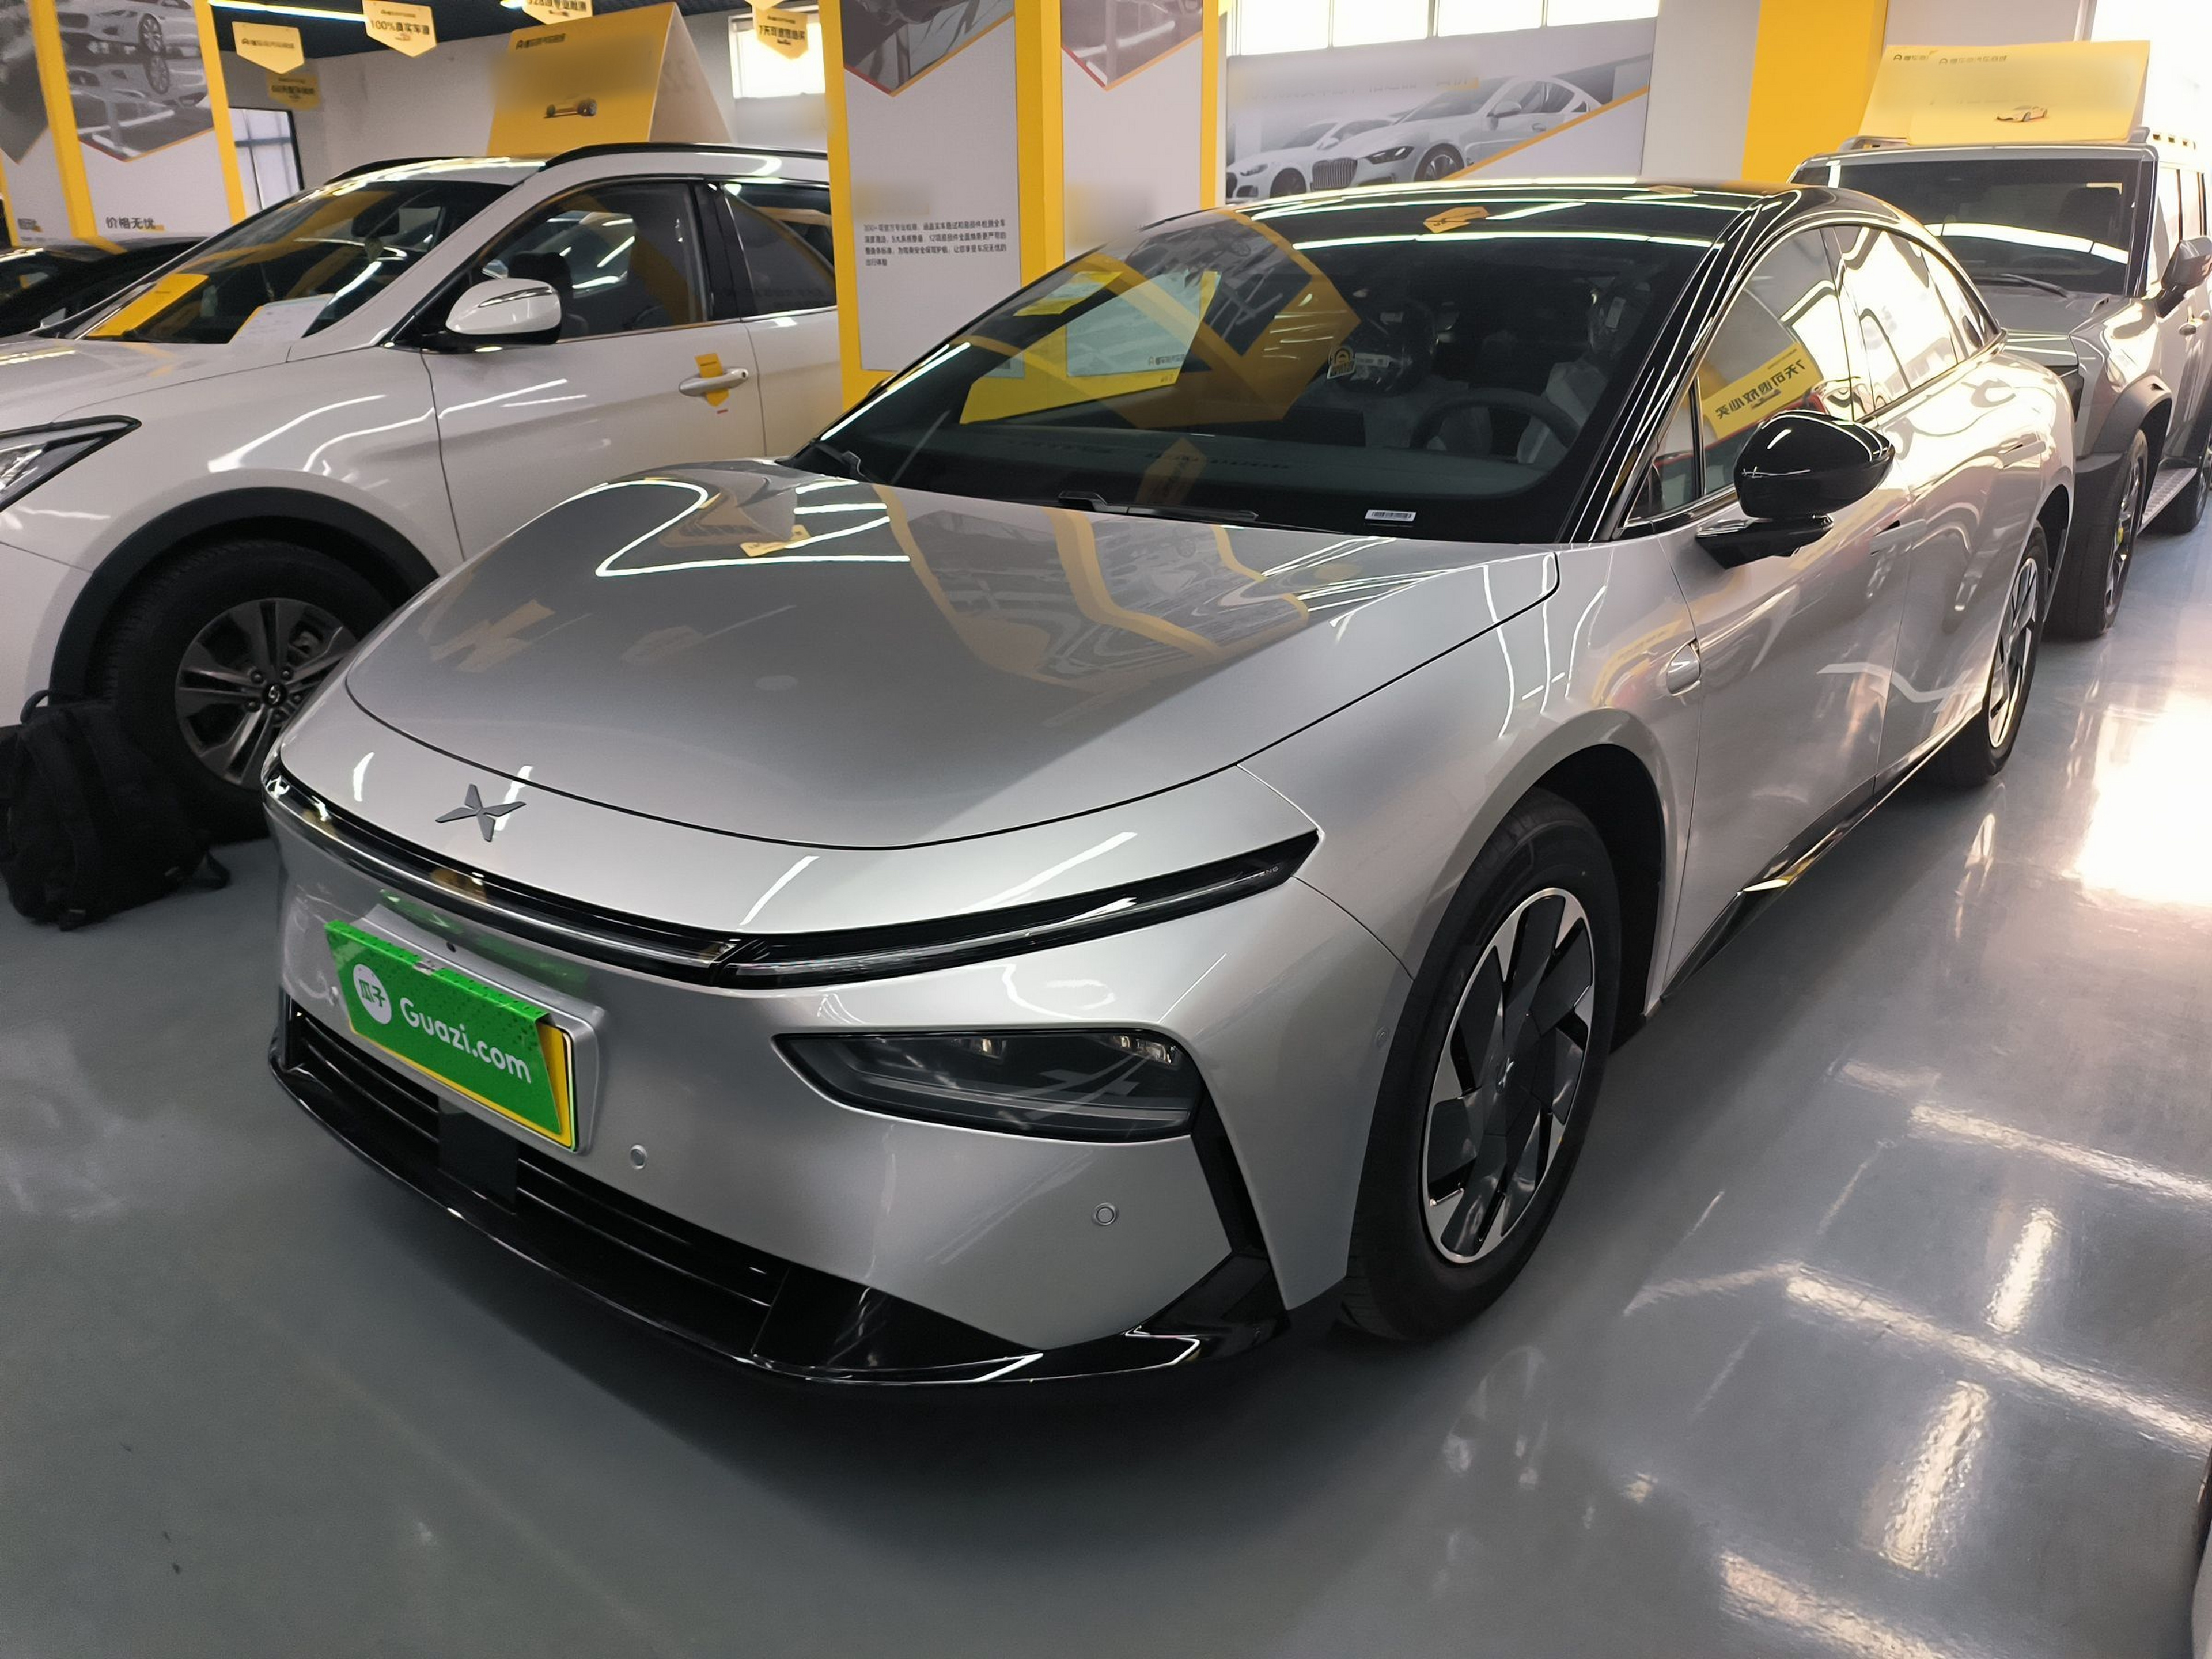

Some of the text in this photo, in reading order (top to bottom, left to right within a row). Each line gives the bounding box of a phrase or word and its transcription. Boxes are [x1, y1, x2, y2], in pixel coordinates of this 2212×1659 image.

[106, 217, 156, 229] 价格无忧
[358, 977, 386, 1009] 瓜子
[400, 997, 532, 1084] Guazi.com
